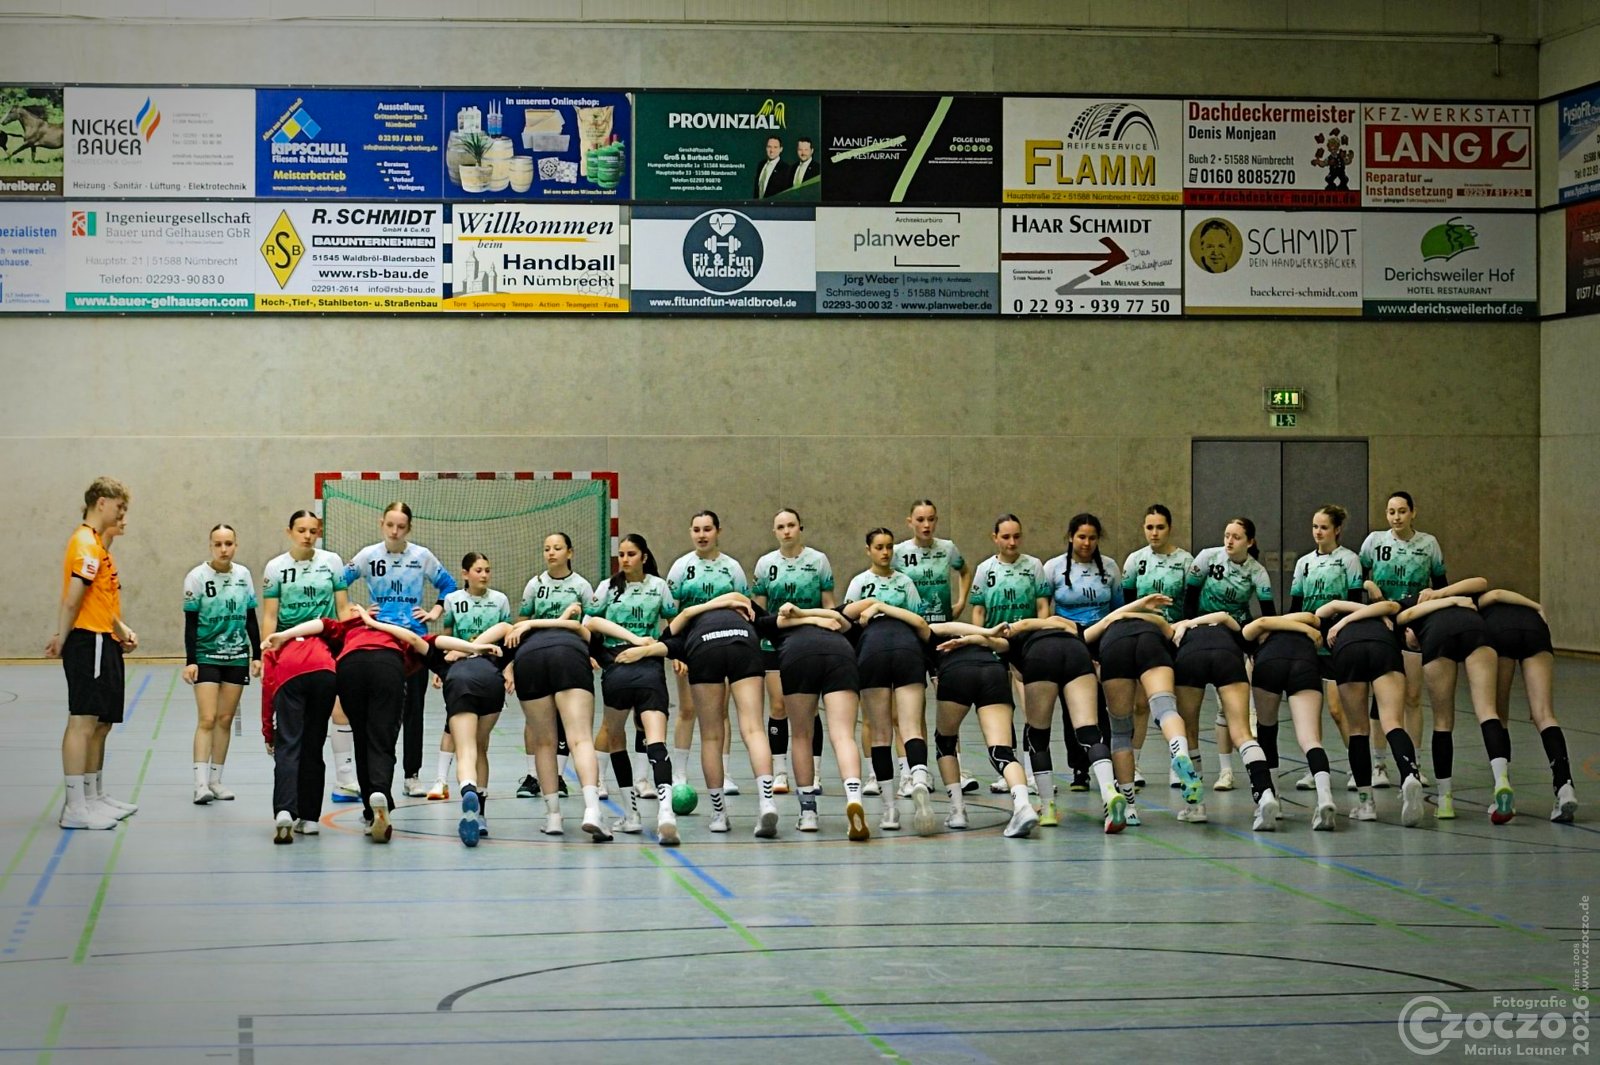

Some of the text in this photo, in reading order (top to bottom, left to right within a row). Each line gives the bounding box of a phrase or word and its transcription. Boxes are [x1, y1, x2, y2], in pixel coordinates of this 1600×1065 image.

[378, 103, 424, 112] Ausstellung
[551, 98, 599, 106] Onlineshop:
[1189, 102, 1355, 123] Dachdeckermeister
[1365, 107, 1531, 123] KFZ-WERKSTATT
[73, 119, 138, 135] NICKEL
[669, 113, 780, 130] PROVINZIAL
[1189, 126, 1276, 142] Denis Monjean
[78, 139, 141, 155] BAUER
[271, 143, 348, 155] KIPPSCHULL
[1374, 131, 1482, 163] LANG
[1025, 140, 1156, 186] FLAMM
[1189, 154, 1294, 165] Buch 2 51588 Nümbrecht
[274, 170, 346, 180] Meisterbetrieb
[1201, 169, 1295, 184] 0160 8085270
[1366, 172, 1422, 184] Reparatur
[73, 182, 247, 191] Heizung Sanitär Lüftung Elektrotechnik
[1366, 185, 1453, 198] Instandsetzung
[1007, 192, 1049, 200] Hauptstraße
[1093, 193, 1131, 201] Nümbrecht
[106, 212, 251, 225] Ingenieurgesellschaft
[337, 209, 436, 225] SCHMIDT
[458, 211, 614, 234] Willkommen
[1012, 215, 1151, 233] HAAR SCHMIDT
[106, 227, 250, 238] Bauer und Gelhausen GbR
[314, 238, 433, 247] BAUUNTERNEHMEN
[478, 239, 502, 249] beim
[855, 229, 960, 251] planweber
[1248, 228, 1357, 255] SCHMIDT
[86, 257, 237, 266] Hauptstr. 21 51588 Nümbrecht
[503, 254, 615, 270] Handball
[693, 254, 753, 266] Fit & Fun
[1250, 257, 1356, 268] DEIN HANDWERKSBÄCKER
[319, 269, 428, 279] www.rsb-bau.de
[693, 266, 753, 277] Waldbröl
[1385, 268, 1515, 282] Derichsweiler Hof
[100, 275, 142, 284] Telefon:
[503, 275, 614, 287] in Nümbrecht
[843, 275, 899, 286] Jörg Weber
[826, 288, 890, 298] Schmiedeweg
[939, 288, 988, 297] Nümbrecht
[1250, 287, 1358, 297] baeckerei-schmidt.com
[1438, 287, 1492, 295] RESTAURANT
[75, 297, 248, 307] www.bauer-gelhausen.com
[319, 299, 371, 307] Stahlbeton-
[650, 297, 796, 307] www.fitundfun-waldbroel.de
[901, 302, 992, 311] www.planweber.de
[1014, 300, 1169, 312] 0 22 93 939 77 50
[1378, 303, 1523, 314] www.derichsweilerhof.de
[1375, 546, 1391, 561] 18
[903, 554, 917, 568] 14
[369, 560, 386, 576] 16
[687, 566, 695, 579] 8
[769, 566, 778, 581] 9
[1139, 560, 1146, 575] 3
[281, 568, 296, 583] 17
[987, 572, 995, 587] 5
[205, 581, 216, 597] 6
[455, 601, 468, 613] 10
